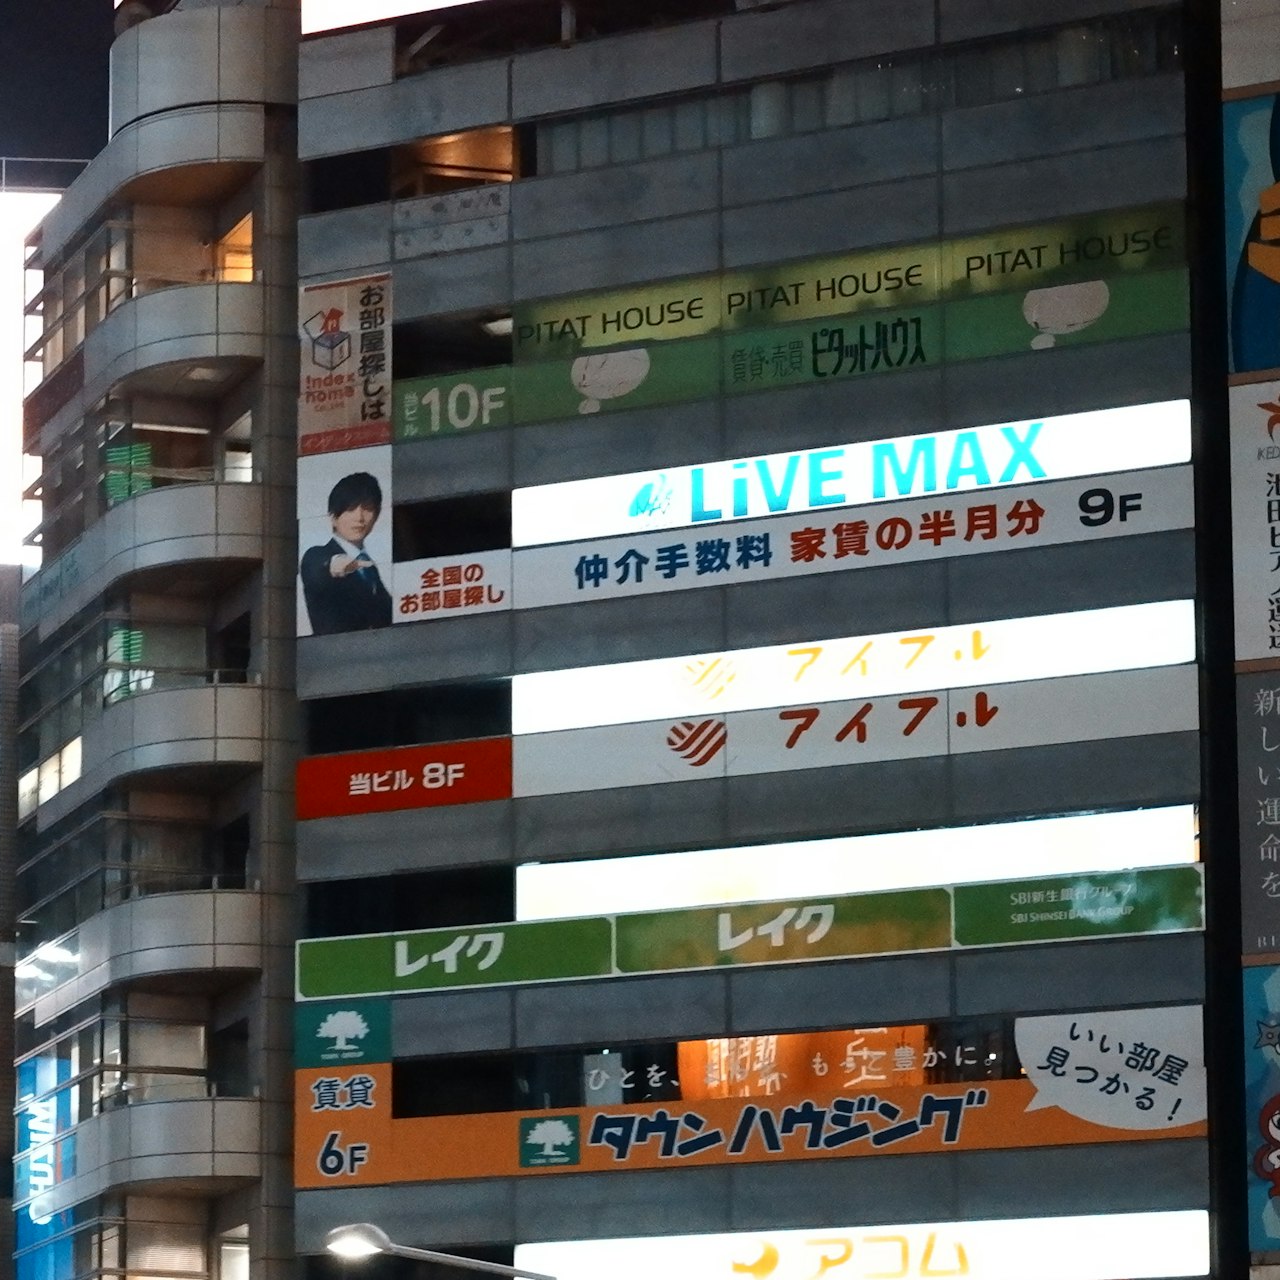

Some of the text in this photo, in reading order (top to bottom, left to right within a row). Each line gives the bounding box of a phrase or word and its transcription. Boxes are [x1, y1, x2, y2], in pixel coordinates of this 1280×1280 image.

[966, 226, 1172, 280] PITAT HOUSE
[728, 264, 923, 315] PITAT HOUSE
[519, 297, 704, 345] PITAT HOUSE
[358, 285, 385, 422] お部屋探しは
[812, 316, 926, 378] ピタットハウス
[421, 383, 507, 433] 10F
[872, 422, 1048, 498] MAX
[574, 488, 1143, 590] 仲介手数料 家賃の半月分 9F
[400, 585, 505, 615] お部屋探し
[420, 563, 484, 589] 全国の
[788, 629, 991, 682] アイフル
[778, 691, 999, 749] アイフル
[348, 763, 466, 797] 当ビル 8F
[718, 903, 835, 952] レイク
[394, 932, 505, 977] レイク
[1069, 1021, 1190, 1088] いい部屋
[311, 1073, 376, 1112] 賃貸
[317, 1131, 368, 1177] 6F
